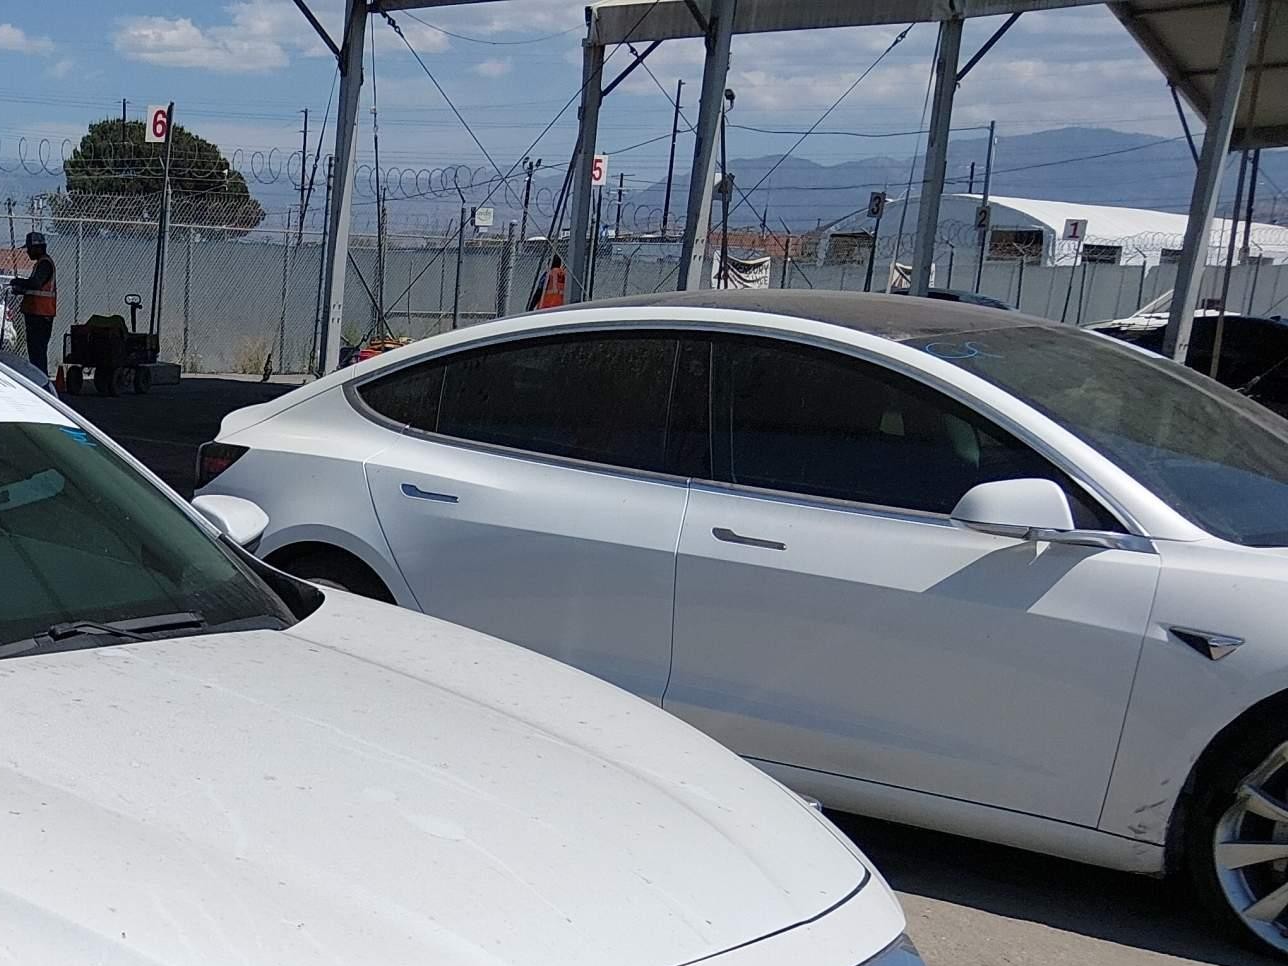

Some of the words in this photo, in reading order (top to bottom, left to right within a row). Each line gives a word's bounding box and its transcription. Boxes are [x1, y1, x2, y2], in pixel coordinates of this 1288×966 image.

[152, 109, 167, 138] 6
[592, 159, 603, 181] 5
[871, 195, 882, 215] 3
[977, 210, 987, 228] 2
[1067, 221, 1080, 239] 1
